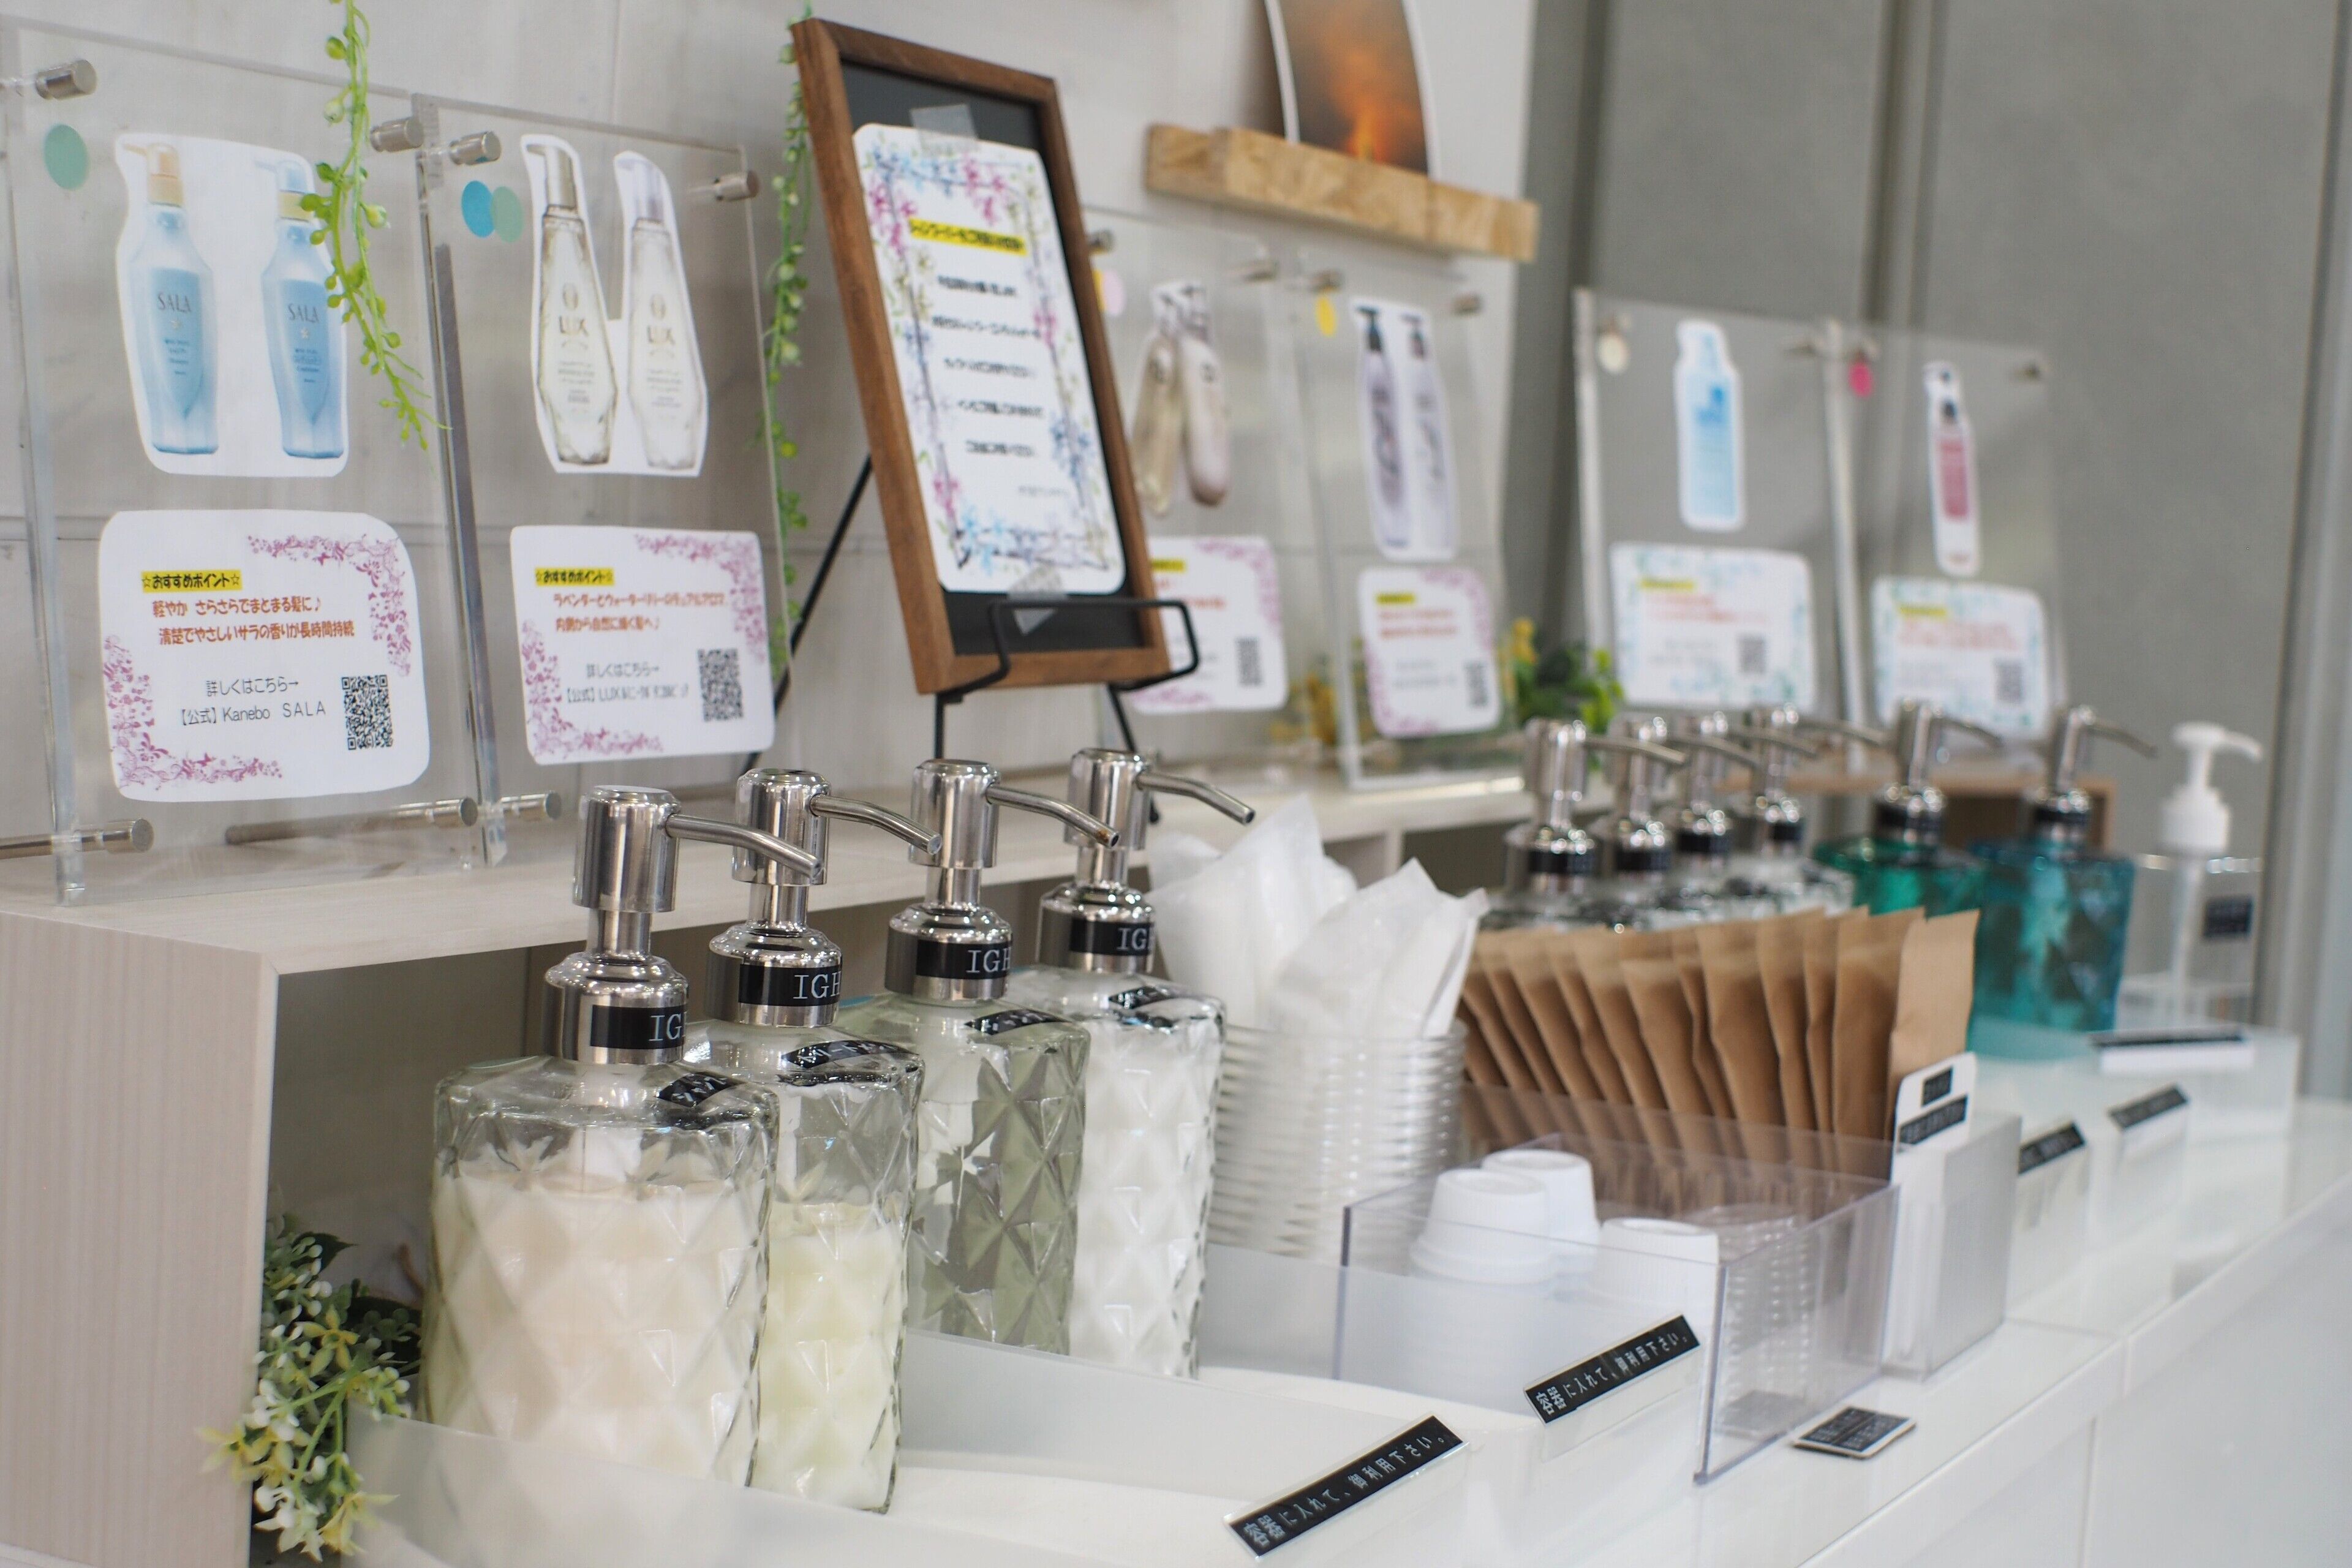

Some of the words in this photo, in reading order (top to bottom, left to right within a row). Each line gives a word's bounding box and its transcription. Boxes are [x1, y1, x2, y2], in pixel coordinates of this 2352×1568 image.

[157, 291, 191, 313] SALA
[288, 303, 319, 323] SALA
[223, 706, 271, 722] Kanebo
[282, 701, 326, 718] SALA
[649, 1011, 687, 1041] IG
